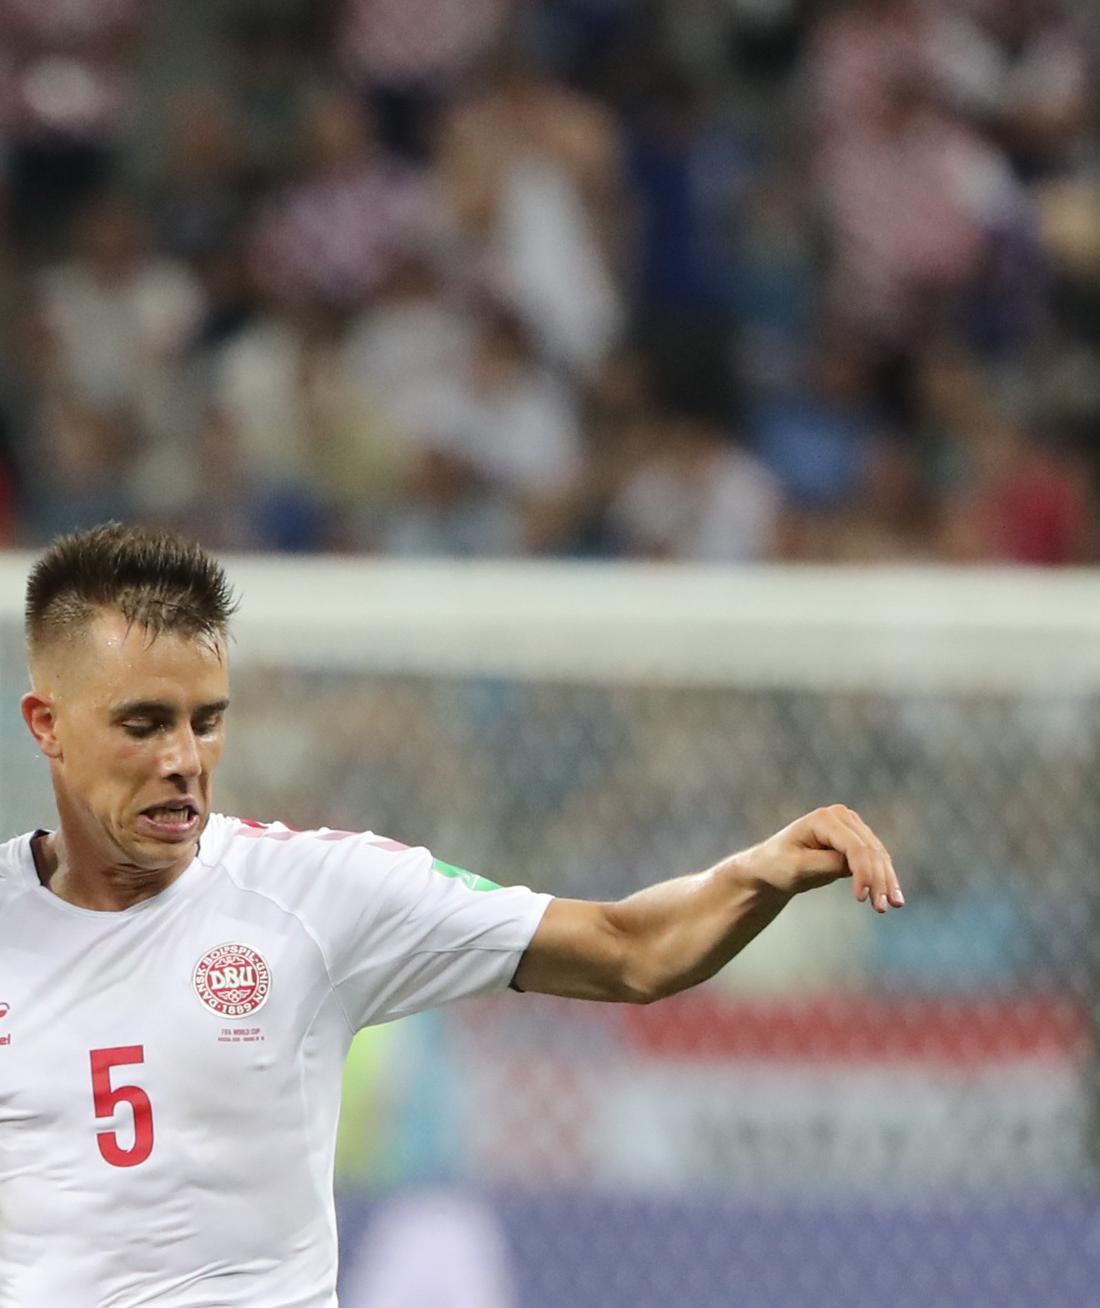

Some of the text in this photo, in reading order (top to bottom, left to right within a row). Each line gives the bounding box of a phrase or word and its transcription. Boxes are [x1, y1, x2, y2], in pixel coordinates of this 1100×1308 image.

[196, 968, 218, 1008] DANSK
[208, 965, 256, 990] DBU
[253, 962, 268, 1003] UNION
[221, 1003, 253, 1015] 1889
[89, 1044, 155, 1168] 5
